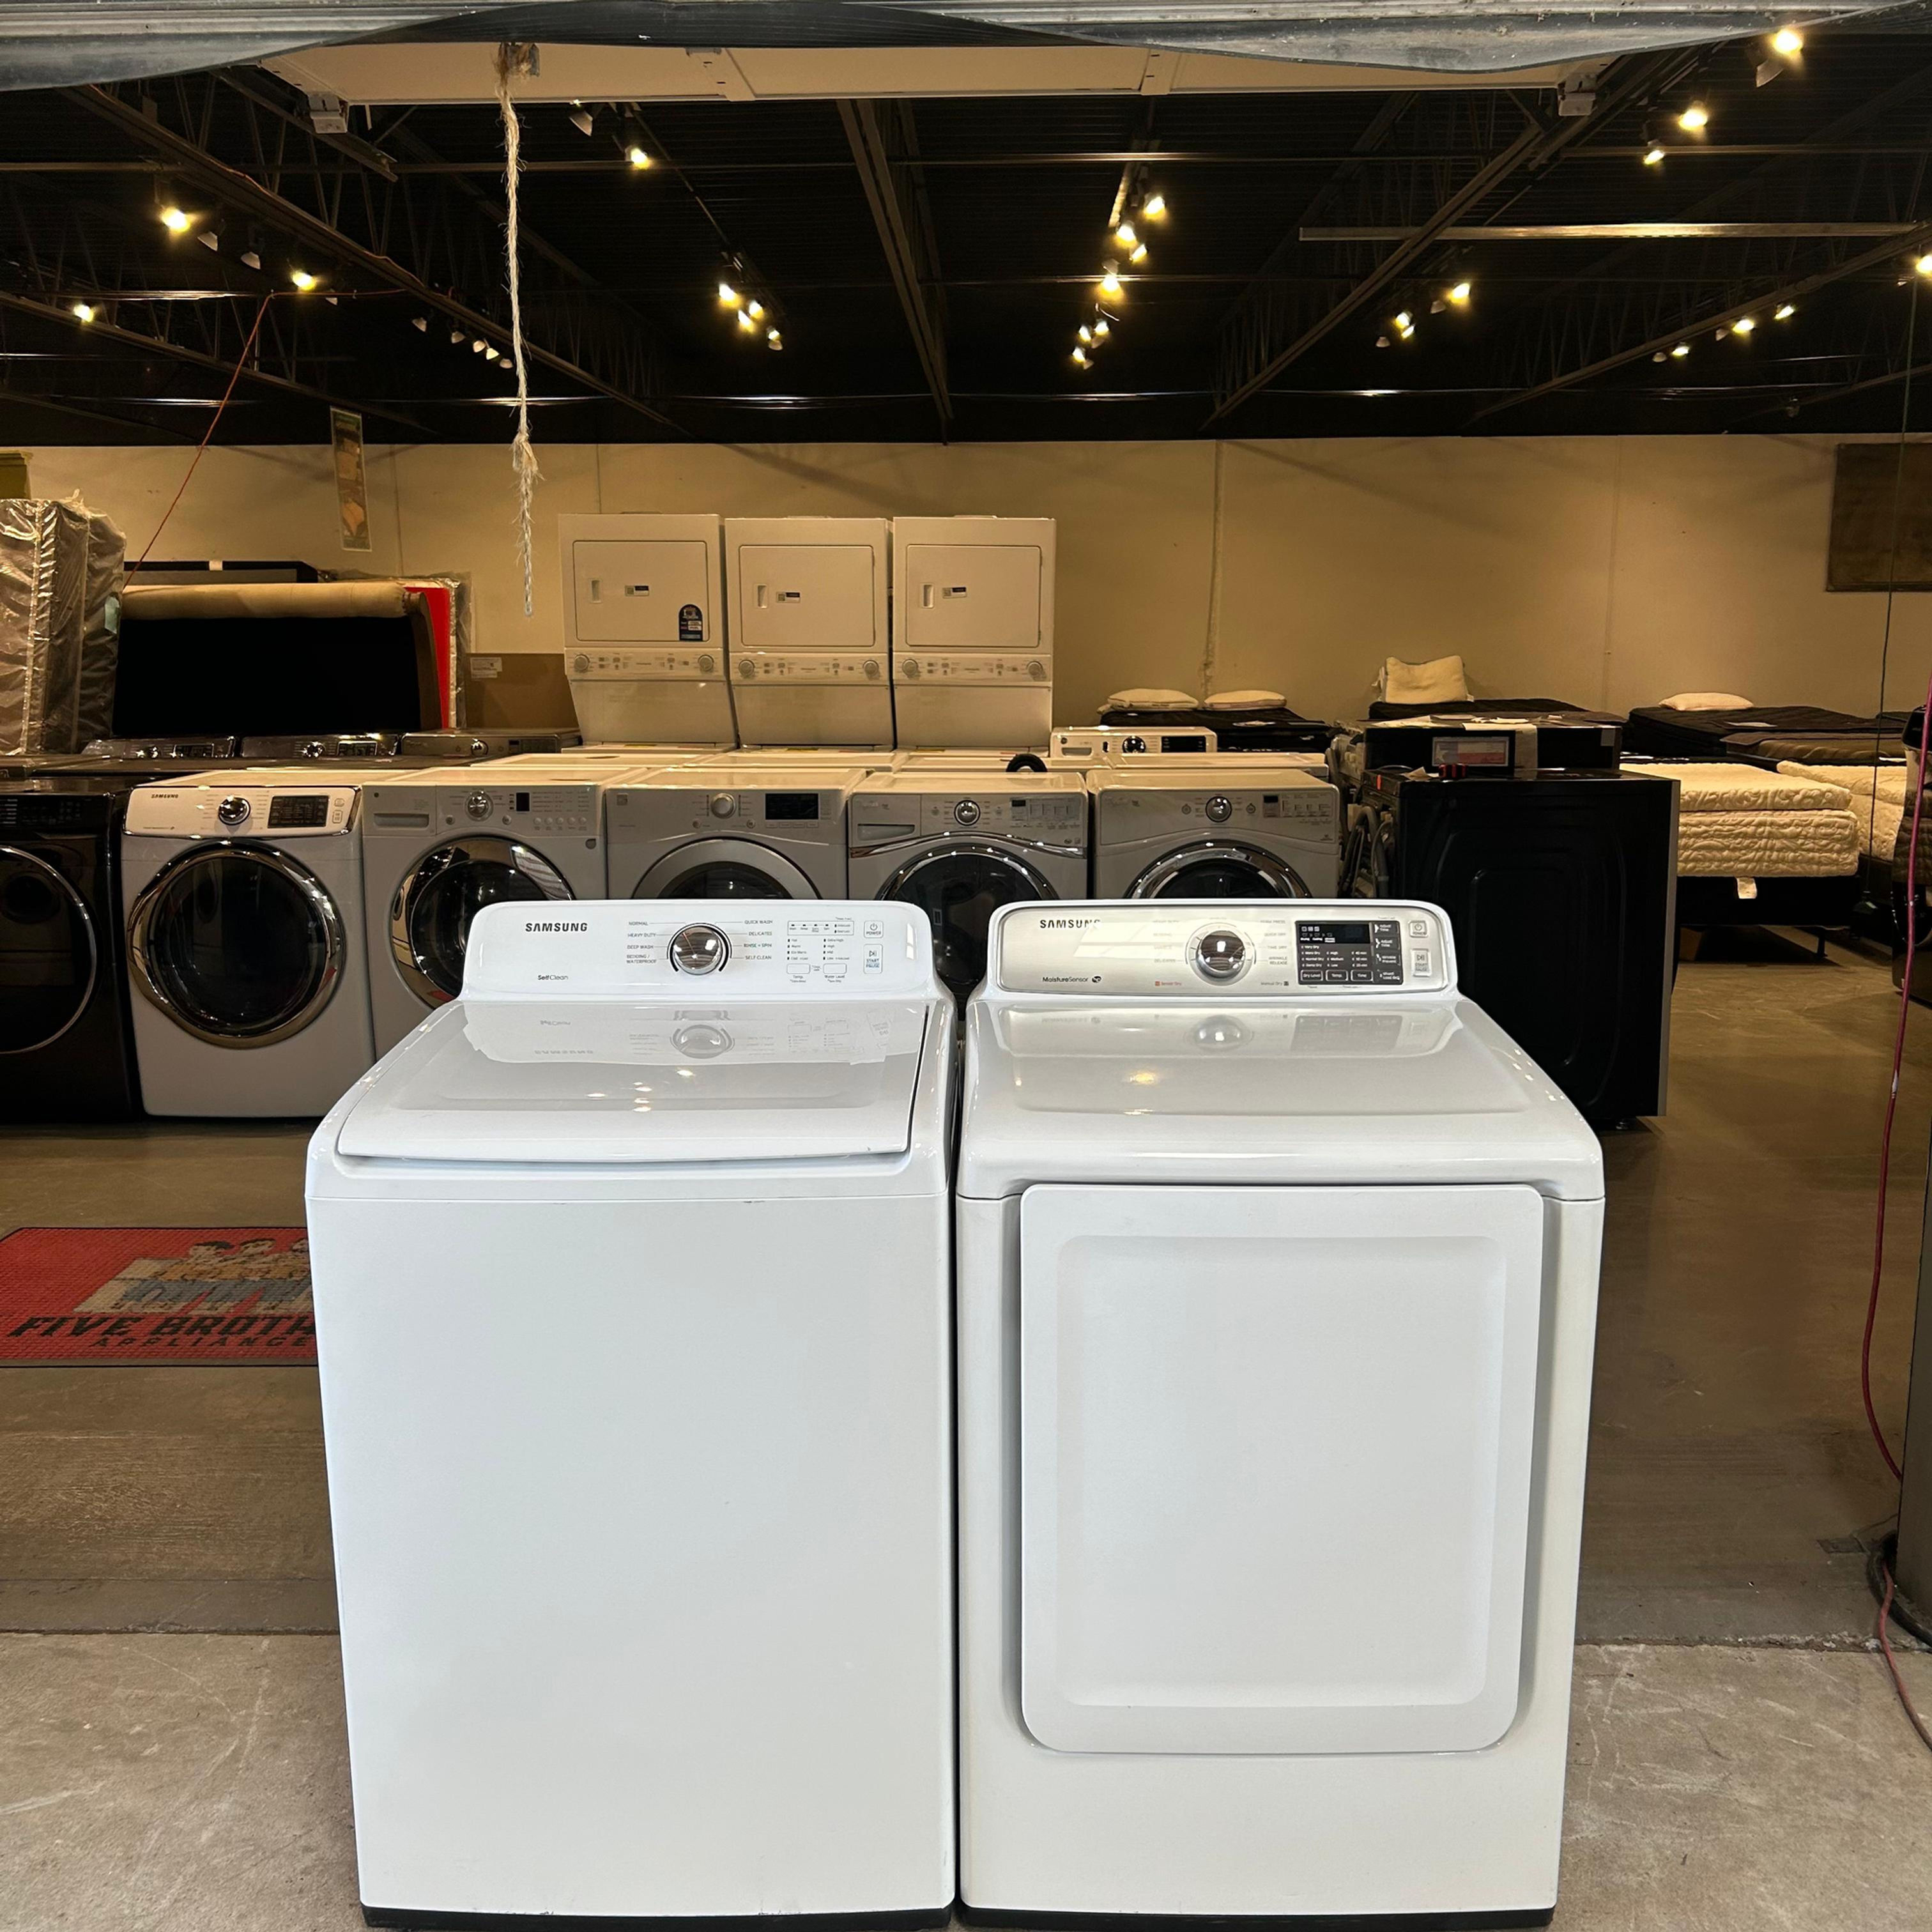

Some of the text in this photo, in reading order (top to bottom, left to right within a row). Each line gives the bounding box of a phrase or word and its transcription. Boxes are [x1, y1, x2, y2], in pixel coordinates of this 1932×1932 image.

[525, 923, 588, 932] SAMSUNG
[1040, 919, 1101, 928] SAMSUN
[6, 1316, 316, 1337] FIVE BROTH
[88, 1337, 310, 1347] APPLIANCE
